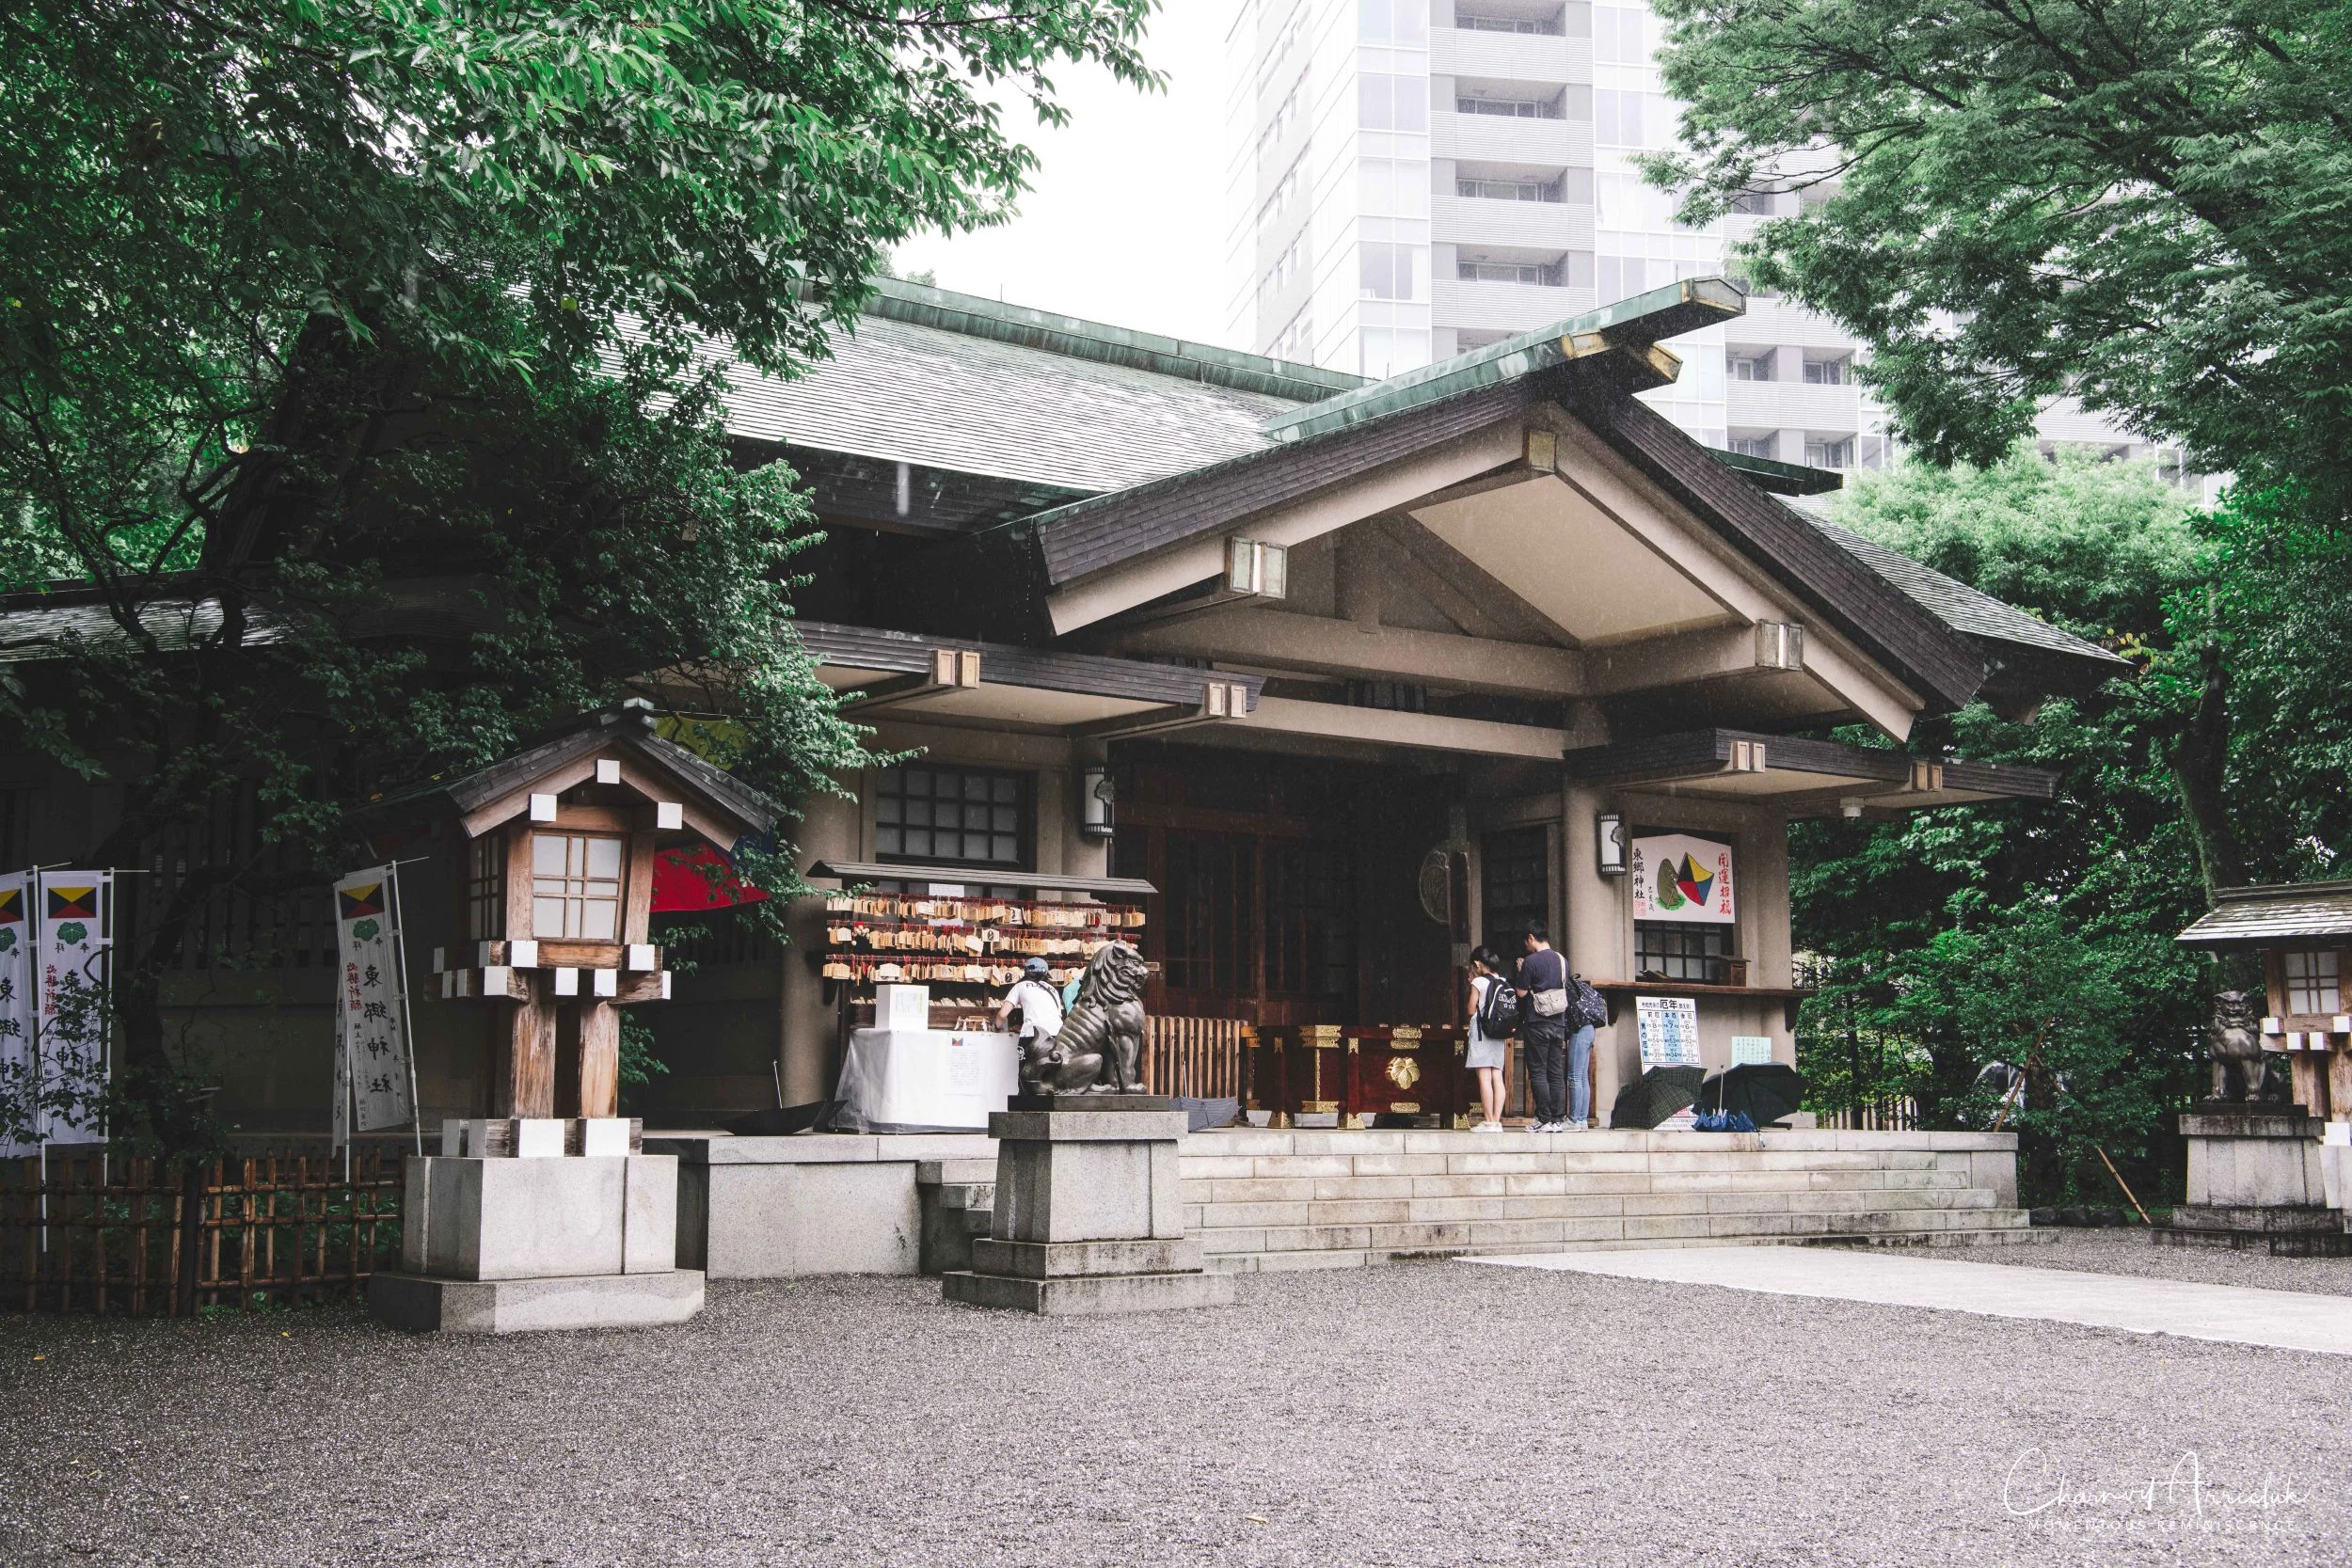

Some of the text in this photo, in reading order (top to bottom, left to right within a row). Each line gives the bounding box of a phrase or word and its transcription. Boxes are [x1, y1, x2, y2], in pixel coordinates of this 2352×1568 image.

[1632, 847, 1645, 899] 東郷神社
[1718, 851, 1732, 915] 開運招福
